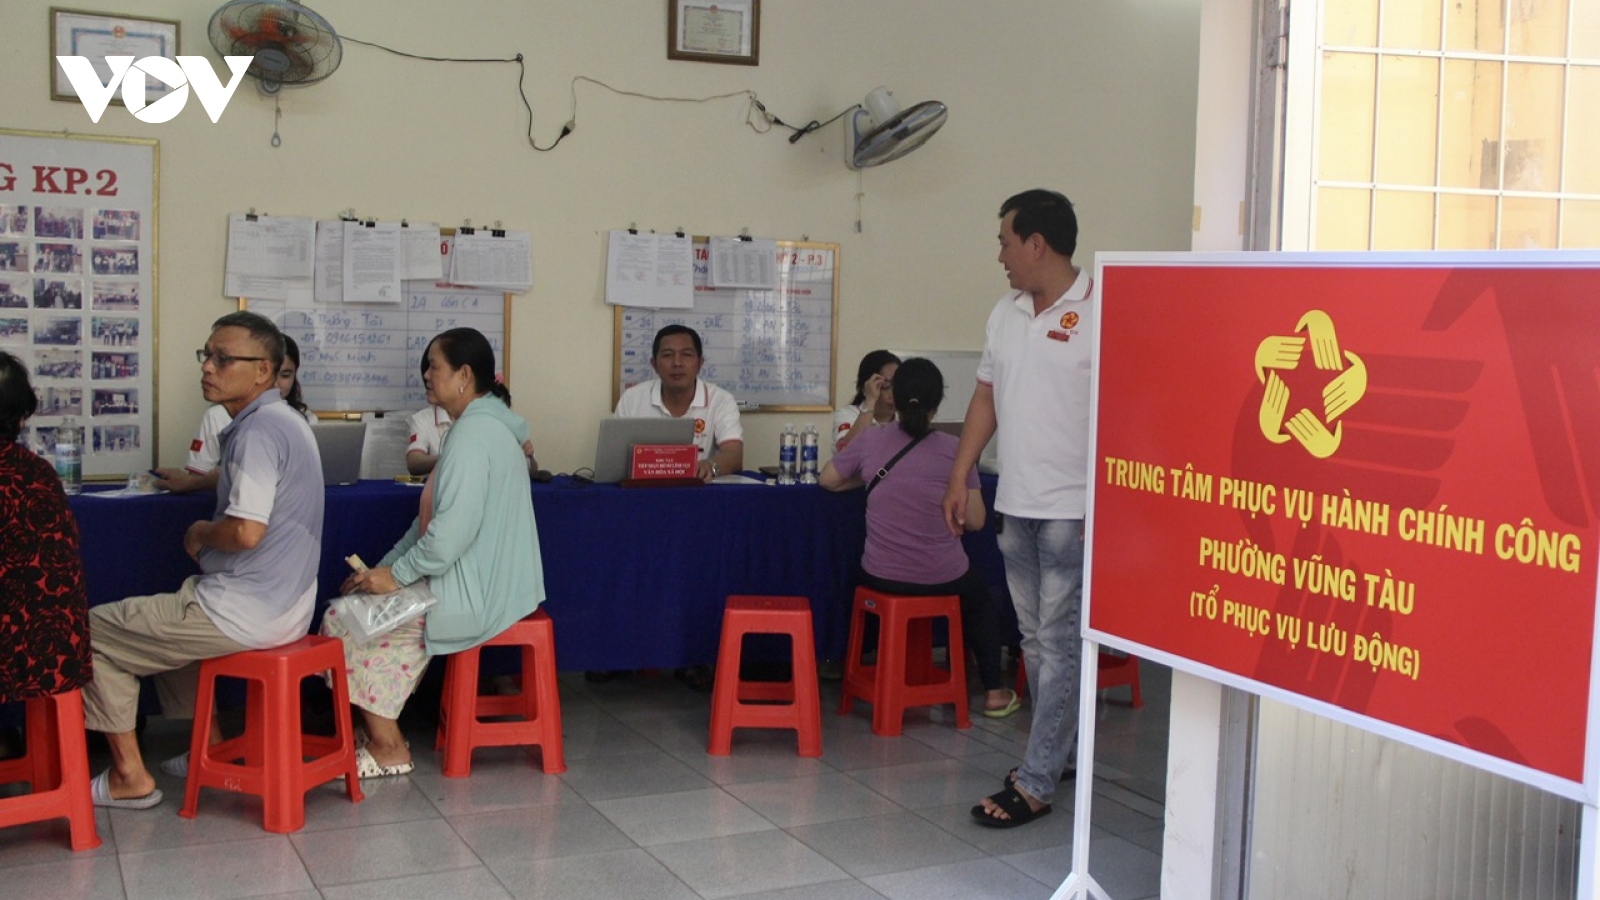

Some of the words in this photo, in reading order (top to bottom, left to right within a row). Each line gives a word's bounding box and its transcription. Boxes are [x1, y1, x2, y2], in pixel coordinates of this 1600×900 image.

[32, 164, 119, 197] KP.2
[791, 253, 798, 266] 2
[808, 254, 823, 266] P.3
[1105, 457, 1165, 494] TRUNG
[1170, 462, 1213, 503] TÂM
[1219, 476, 1278, 520] PHỤC
[1283, 487, 1314, 528] VỤ
[1321, 488, 1390, 537] HÀNH
[1398, 504, 1485, 555] CHÍNH
[1494, 517, 1581, 574] CÔNG
[1199, 537, 1286, 586] PHƯỜNG
[1293, 554, 1357, 602] VŨNG
[1363, 568, 1415, 615] TÀU
[1189, 584, 1220, 620] (TỔ
[1222, 599, 1271, 637] PHỤC
[1276, 613, 1301, 645] VỤ
[1306, 621, 1347, 657] LƯU
[1353, 634, 1420, 681] ĐỘNG)
